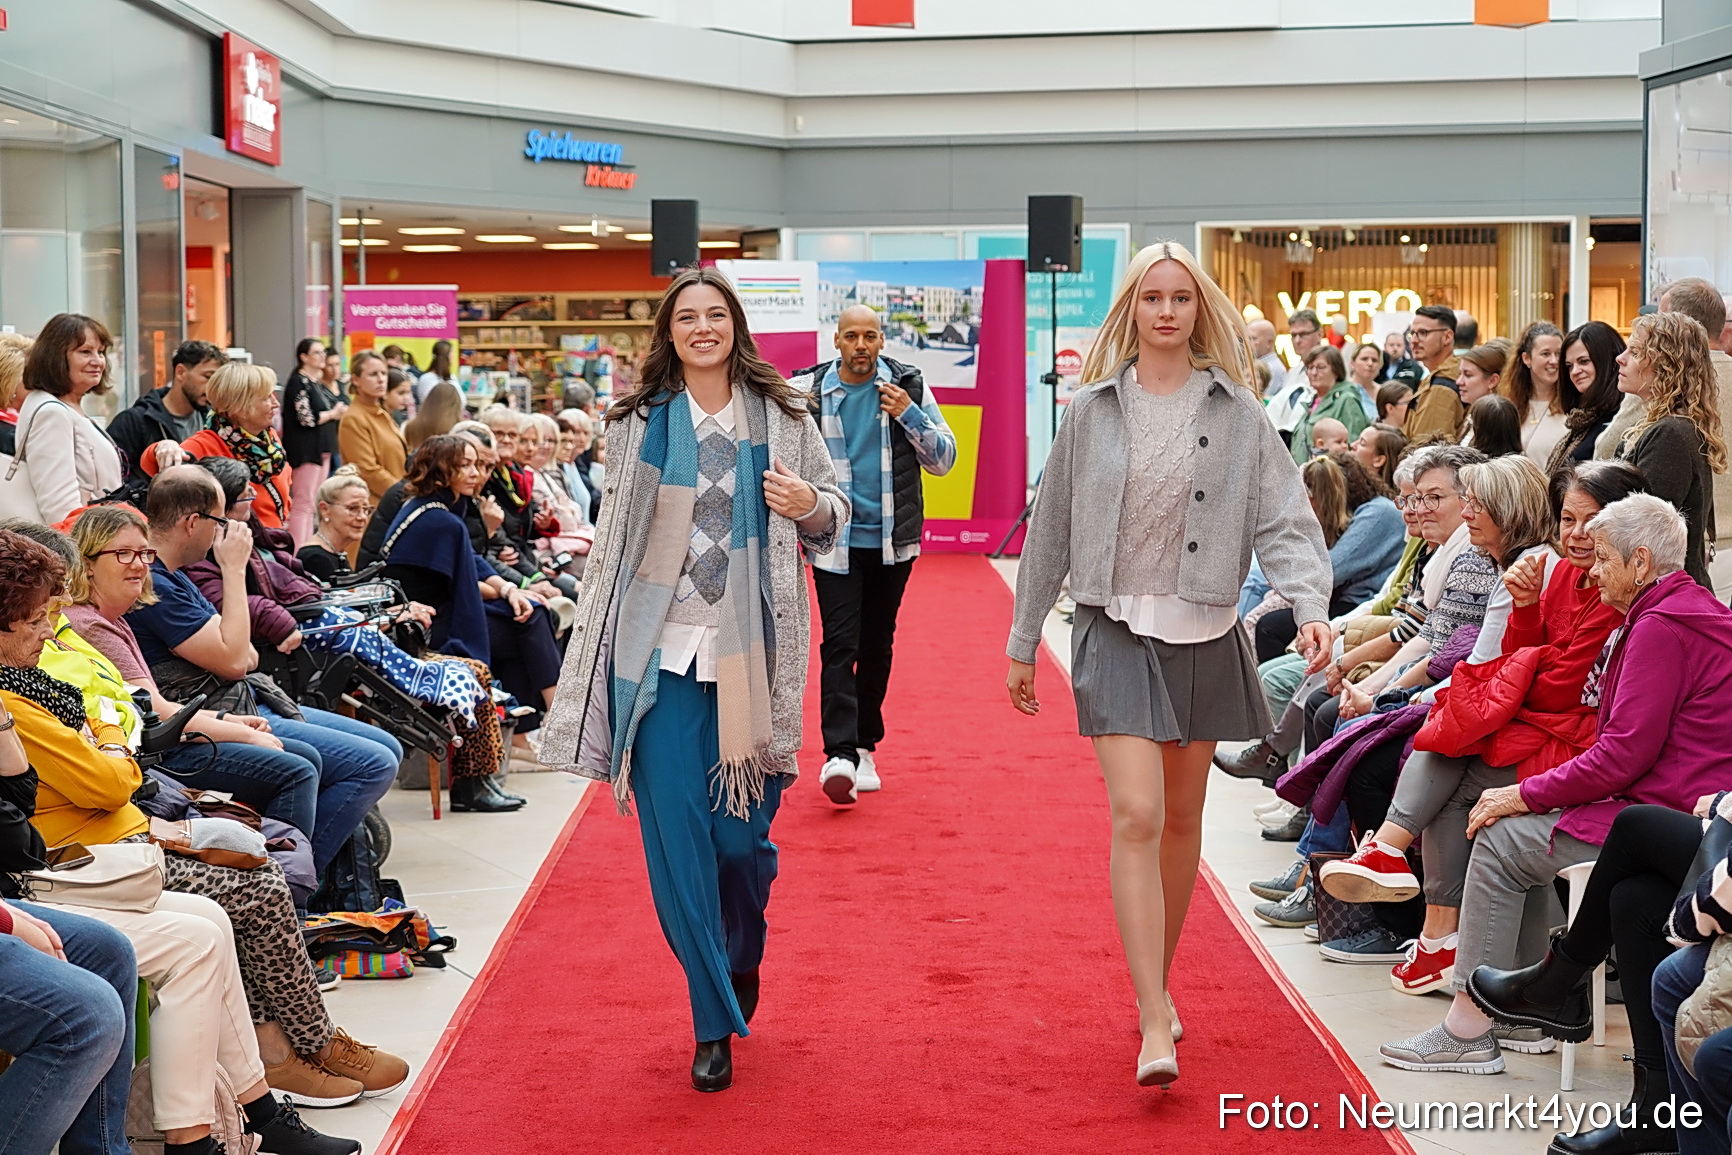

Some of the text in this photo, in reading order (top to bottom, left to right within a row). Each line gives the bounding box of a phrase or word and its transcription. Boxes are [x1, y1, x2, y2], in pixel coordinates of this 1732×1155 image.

[525, 129, 623, 164] Spielwaren
[350, 302, 447, 317] Verschenken Sie
[1277, 288, 1423, 325] VERO
[374, 316, 448, 330] Gutscheine!
